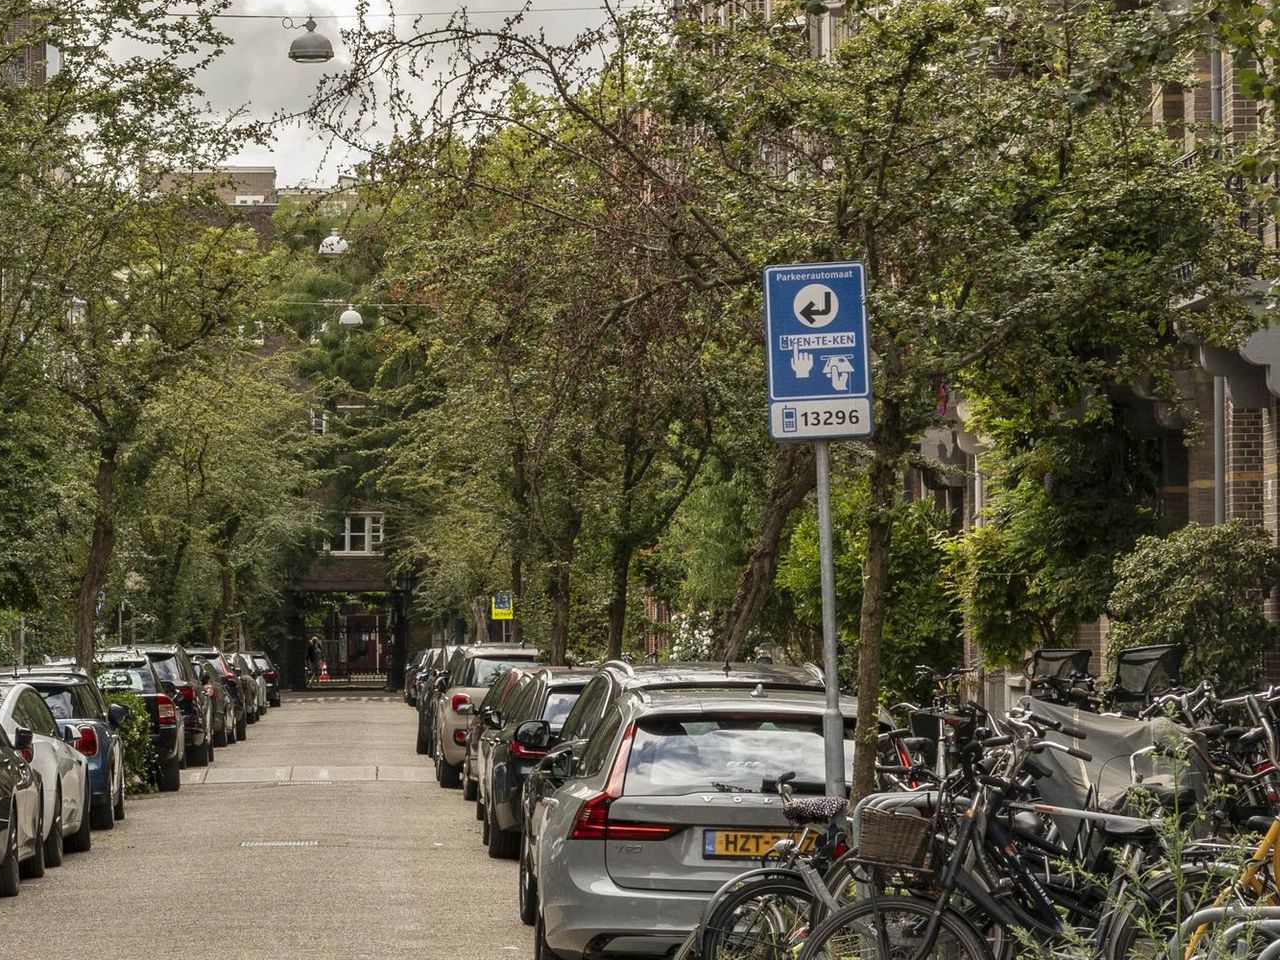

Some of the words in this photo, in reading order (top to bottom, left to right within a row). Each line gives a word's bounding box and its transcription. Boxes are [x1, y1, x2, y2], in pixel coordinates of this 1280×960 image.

[776, 270, 853, 282] Parkeerautomaat
[789, 334, 854, 347] KEN-TE-KEN
[800, 409, 860, 427] 13296
